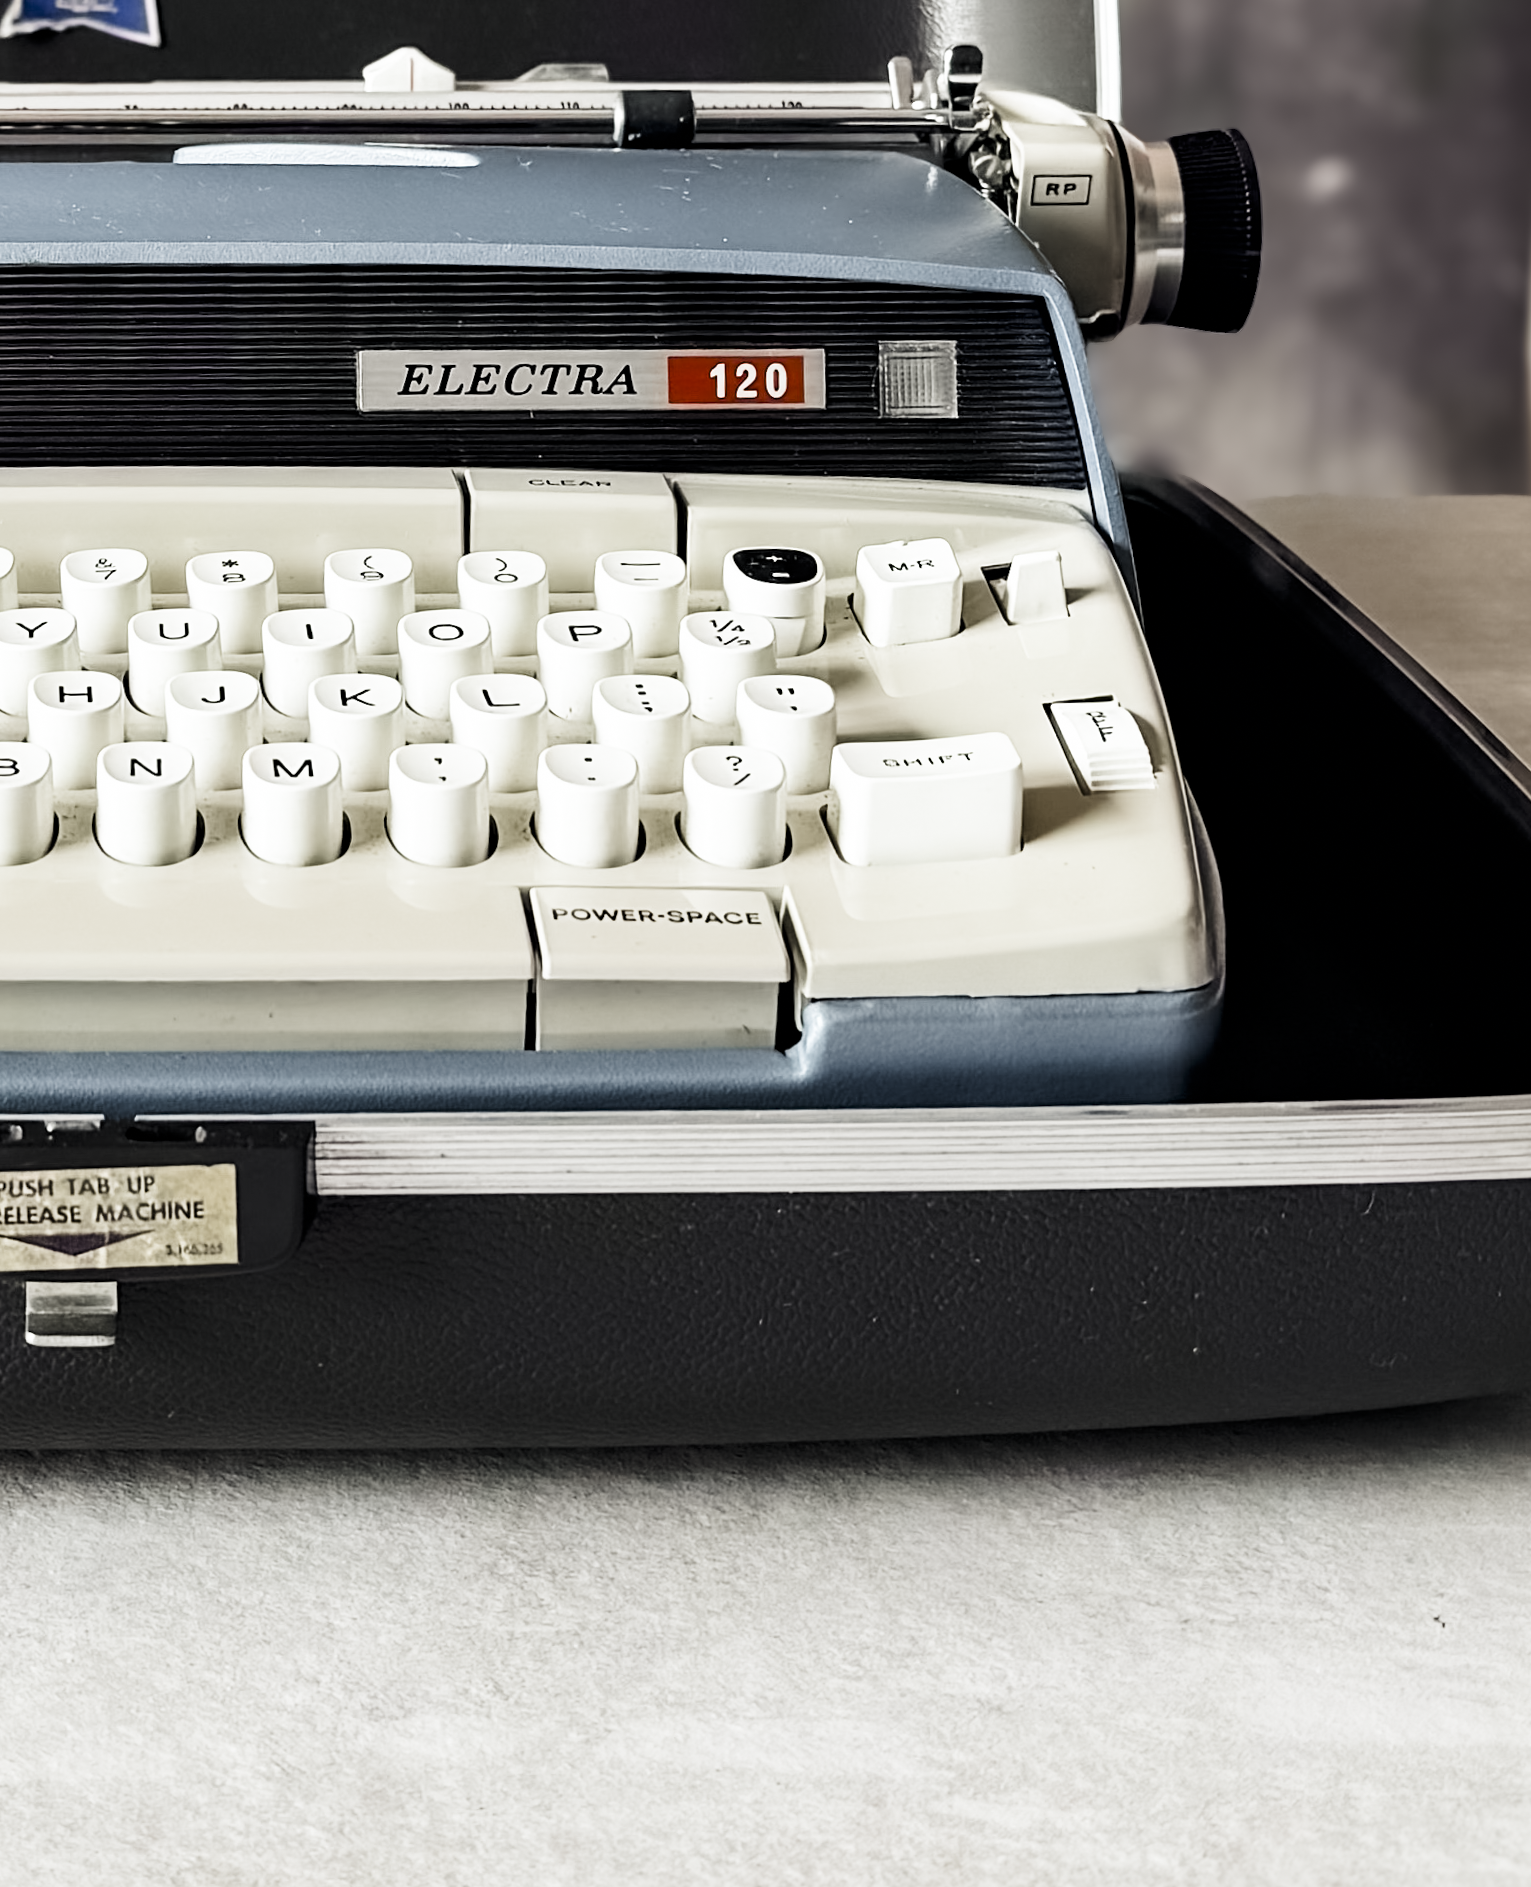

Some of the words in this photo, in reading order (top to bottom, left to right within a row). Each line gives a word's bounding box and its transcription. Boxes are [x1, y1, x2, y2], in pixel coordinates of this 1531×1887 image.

[1046, 183, 1076, 196] RP
[397, 364, 637, 395] ELECTRA
[710, 363, 787, 398] 120
[528, 479, 611, 487] CLEAR
[16, 622, 47, 638] Y
[159, 623, 189, 639] U
[429, 624, 464, 640] O
[569, 625, 602, 641] P
[59, 686, 93, 703] H
[202, 686, 225, 703] J
[340, 689, 374, 706] K
[482, 689, 520, 707] L
[883, 751, 975, 766] SHIFT
[130, 759, 162, 776] N
[273, 759, 313, 777] M
[553, 909, 761, 924] POWER-SPACE
[69, 1178, 110, 1195] TAB
[127, 1176, 155, 1193] UP
[96, 1201, 205, 1223] MACHINE
